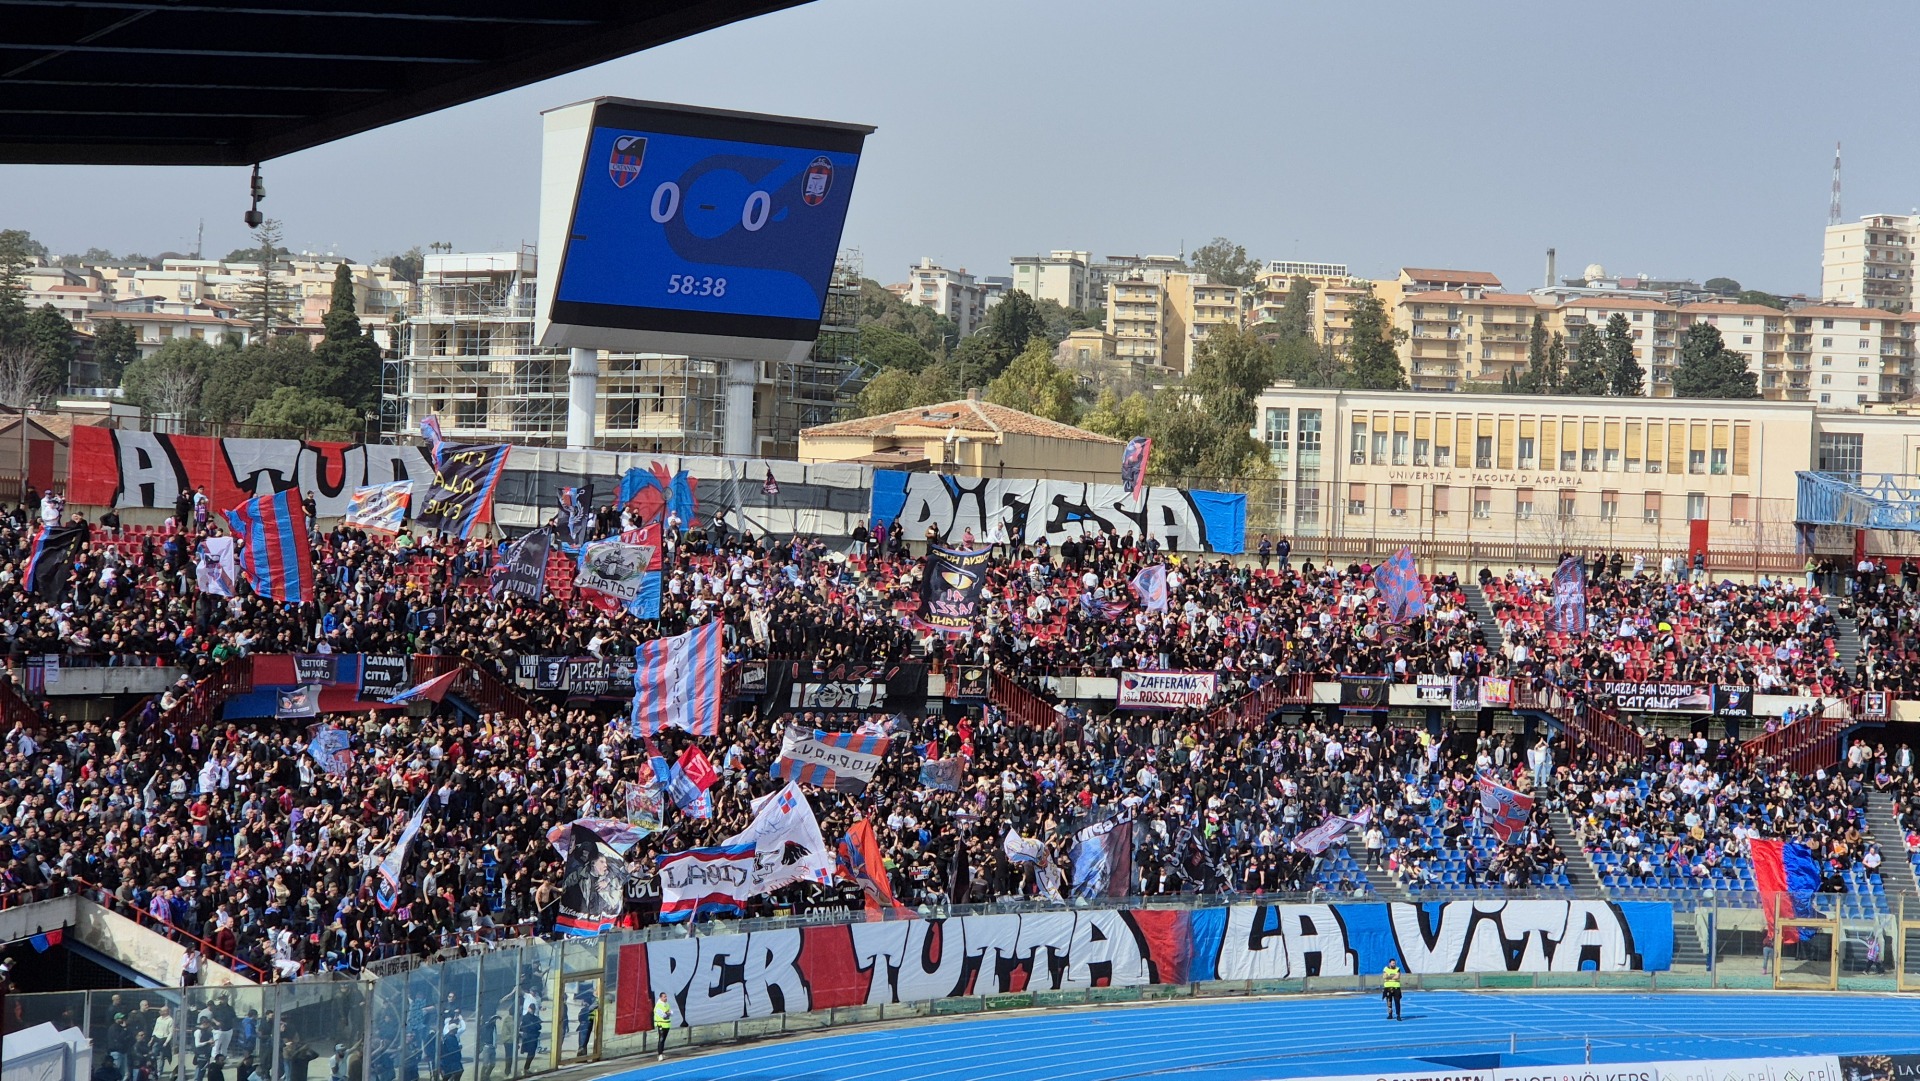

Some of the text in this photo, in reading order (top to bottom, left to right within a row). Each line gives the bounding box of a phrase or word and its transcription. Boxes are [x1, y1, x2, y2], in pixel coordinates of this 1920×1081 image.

[650, 181, 680, 224] 0
[742, 190, 771, 232] 0
[667, 274, 727, 298] 58:38
[112, 429, 191, 509] A
[1535, 476, 1583, 485] AGRARIA
[301, 659, 328, 668] SETTORE
[366, 655, 404, 667] CATANIA
[365, 669, 391, 681] CITTÀ
[1140, 675, 1197, 690] ZAFFERANA
[1605, 682, 1691, 696] PIAZZA SAN COSIMO
[1719, 685, 1750, 693] VECCHIO
[363, 685, 399, 696] ETERNA
[1138, 690, 1209, 705] ROSSAZZURRA
[1617, 695, 1679, 709] CATANIA
[804, 905, 852, 922] CATANIA
[645, 928, 812, 1028] PER
[848, 909, 1153, 1005] TUTTA
[1216, 904, 1358, 980] LA
